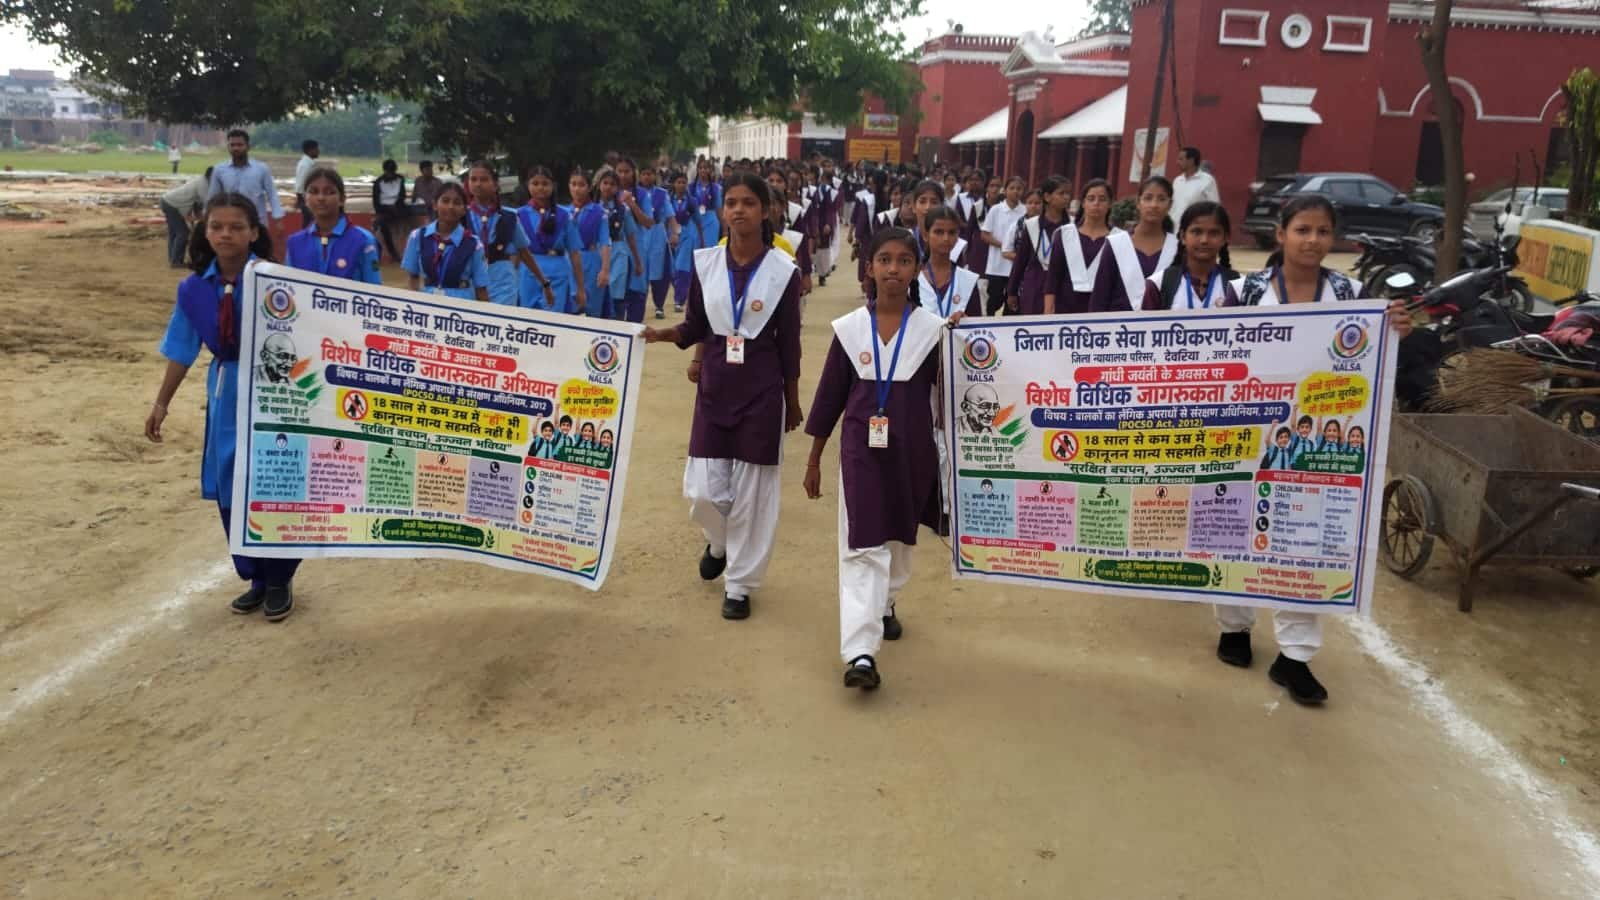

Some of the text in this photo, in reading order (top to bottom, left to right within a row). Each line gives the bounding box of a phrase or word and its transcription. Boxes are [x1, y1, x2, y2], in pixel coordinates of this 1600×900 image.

[312, 289, 348, 313] जिला
[352, 295, 399, 322] विधिक
[402, 304, 429, 328] सेवा
[266, 323, 293, 333] NALSA
[362, 321, 381, 331] जिला
[444, 334, 475, 349] देवरिया
[502, 344, 520, 356] प्रदेश
[1014, 328, 1055, 352] जिला
[1059, 325, 1111, 350] विधिक
[1115, 324, 1147, 348] सेवा
[387, 339, 410, 355] गांधी
[441, 347, 452, 361] के
[454, 353, 482, 366] अवसर
[485, 357, 497, 369] पर
[1071, 351, 1091, 364] जिला
[1093, 352, 1127, 364] न्यायालय
[1164, 350, 1200, 362] देवरिया
[1213, 349, 1229, 360] उत्तर
[1231, 346, 1252, 360] प्रदेश
[320, 337, 362, 366] विशेष
[366, 348, 416, 375] विधिक
[501, 371, 558, 398] अभियान
[1100, 365, 1226, 383] गांधी जयंती के अवसर पर
[1333, 363, 1361, 371] NALSA
[588, 374, 613, 385] NALSA
[967, 374, 995, 383] NALSA
[336, 367, 358, 380] विषय
[457, 384, 466, 396] से
[530, 400, 547, 411] 2012
[403, 389, 434, 401] (POCSO
[1025, 380, 1072, 407] विशेष
[1076, 381, 1132, 407] विधिक
[1230, 376, 1297, 400] अभियान
[372, 397, 386, 408] 18
[390, 399, 413, 413] साल
[417, 398, 426, 413] से
[430, 406, 450, 418] कम
[471, 409, 480, 422] में
[507, 416, 520, 429] भी
[1044, 409, 1067, 421] विषय
[1075, 409, 1103, 422] बालकों
[1104, 411, 1116, 421] का
[1146, 406, 1177, 420] अपराधों
[1180, 405, 1189, 418] से
[1190, 406, 1218, 418] संरक्षण
[1263, 405, 1283, 415] 2012
[373, 410, 514, 441] कानूनन मान्य सहमति नहीं है
[1118, 420, 1153, 430] (POCSO
[1178, 418, 1204, 428] 2012)
[1084, 435, 1099, 446] 18
[1103, 433, 1129, 446] साल
[1133, 431, 1144, 445] से
[1148, 433, 1169, 444] कम
[1195, 430, 1206, 444] में
[1237, 427, 1252, 442] भी
[1083, 443, 1245, 463] कानूनन मान्य सहमति नहीं है
